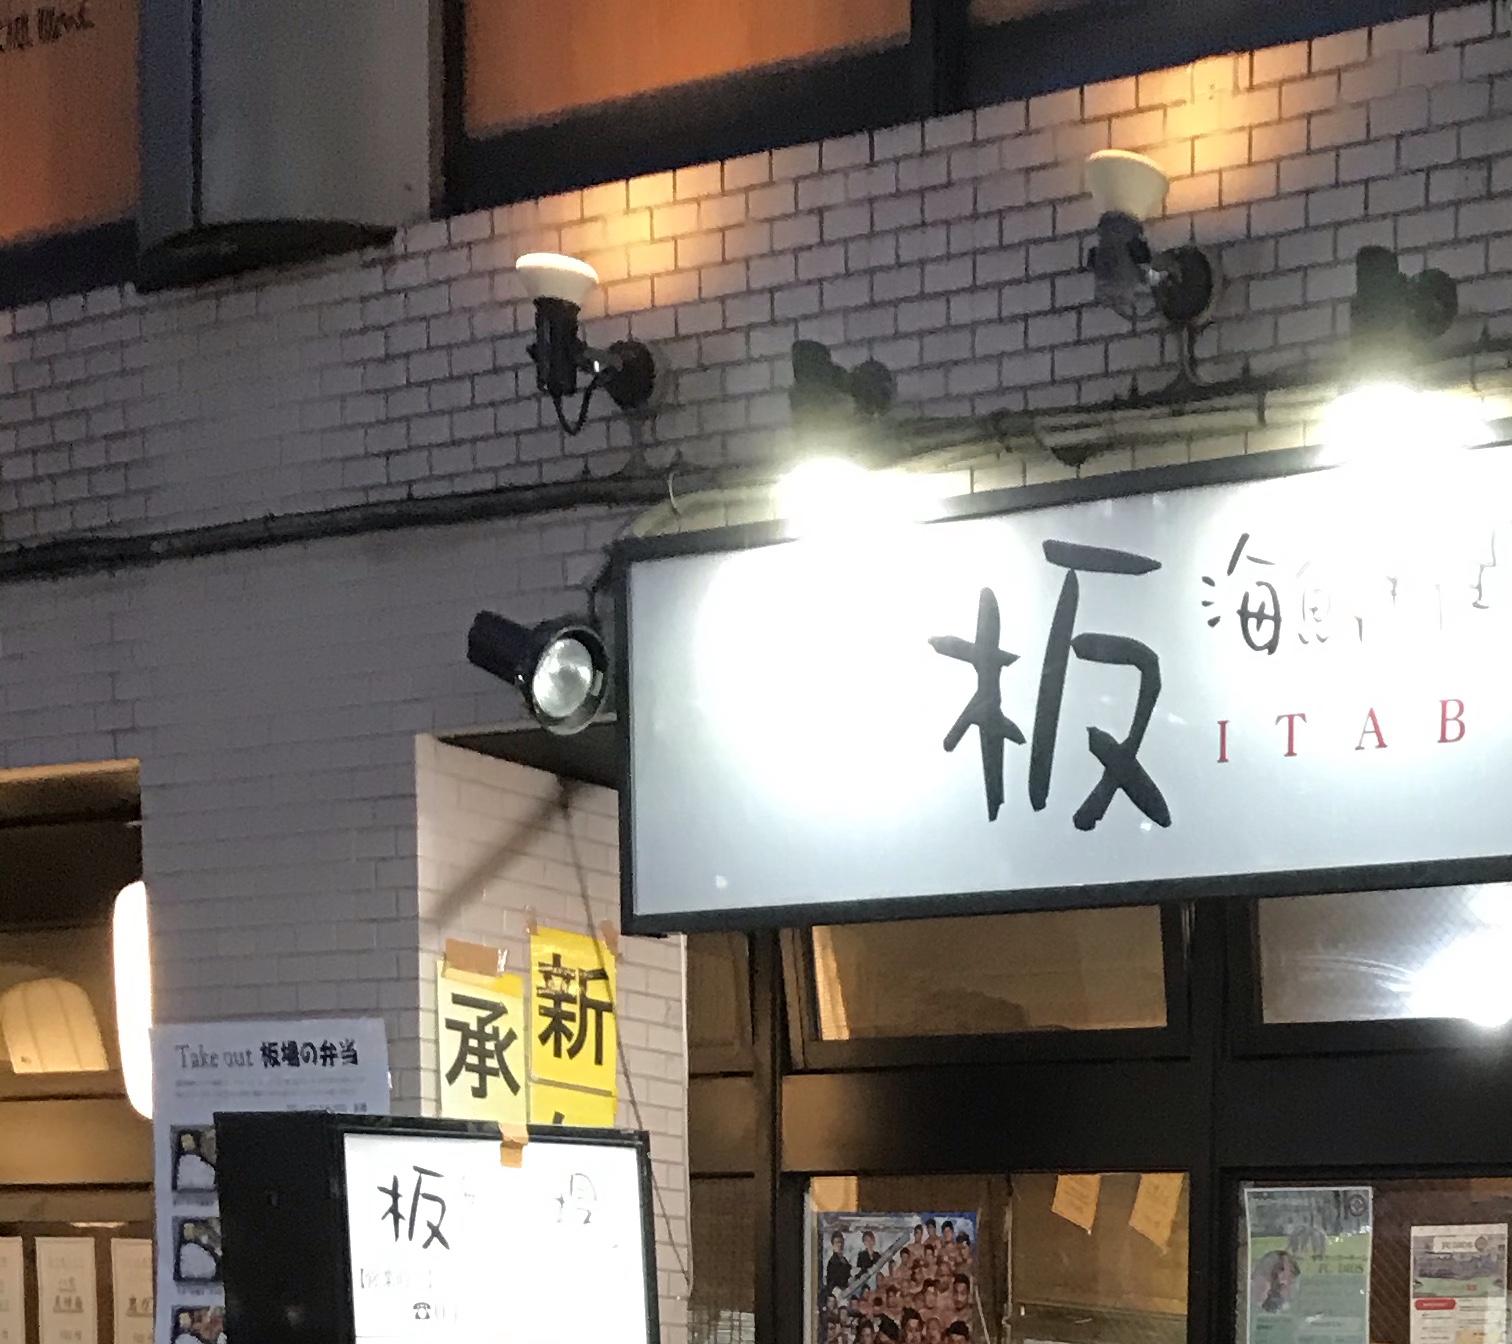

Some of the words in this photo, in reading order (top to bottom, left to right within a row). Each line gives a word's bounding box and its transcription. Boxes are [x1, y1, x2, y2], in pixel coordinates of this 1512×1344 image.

[927, 538, 1172, 832] 板
[175, 1043, 219, 1069] Take
[225, 1049, 253, 1068] out
[260, 1037, 359, 1069] 板場の弁当
[444, 991, 521, 1101] 承
[536, 952, 614, 1067] 新
[375, 1164, 451, 1250] 板
